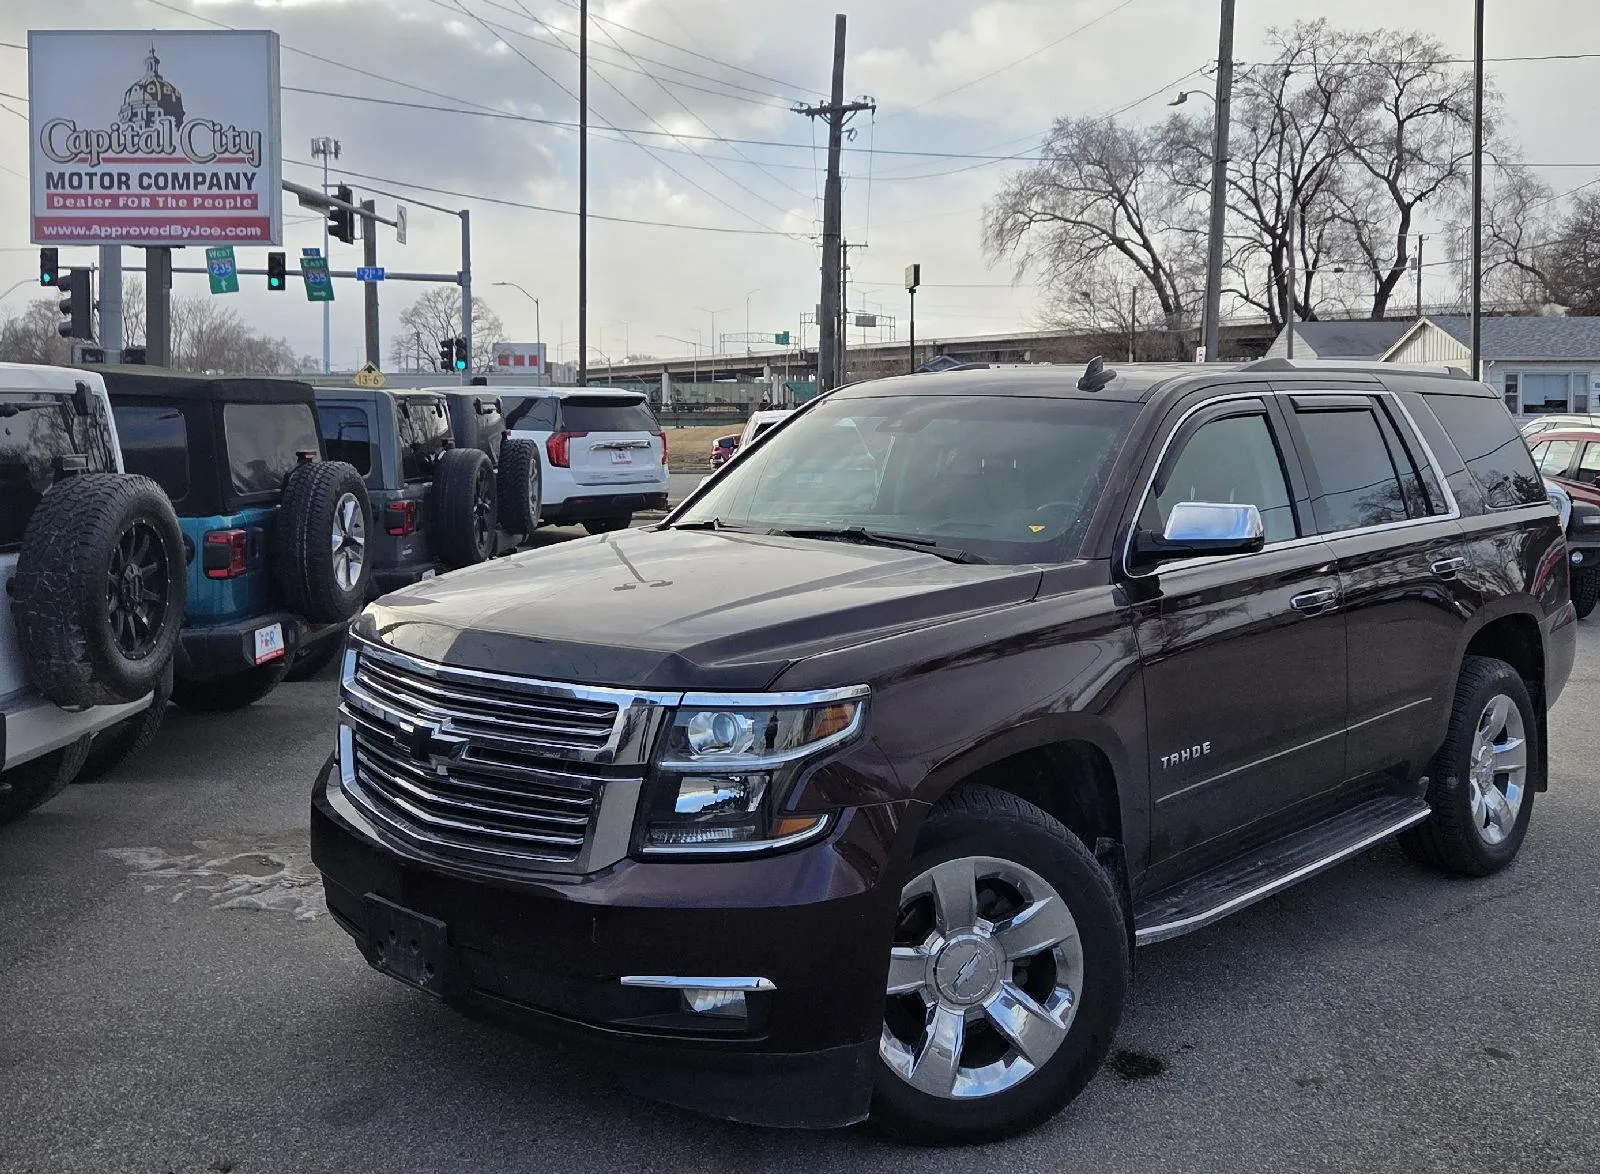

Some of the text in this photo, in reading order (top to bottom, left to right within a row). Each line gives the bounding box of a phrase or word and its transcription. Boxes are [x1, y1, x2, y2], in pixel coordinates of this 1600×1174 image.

[40, 118, 262, 168] Capital City
[45, 172, 257, 191] MOTOR COMPANY
[53, 196, 252, 210] Dealer FOR The People
[43, 224, 262, 239] www.ApprovedByJoe.com
[208, 248, 231, 258] WEST
[212, 263, 232, 274] 235
[308, 272, 328, 283] 235
[1160, 741, 1212, 769] TAHOE
